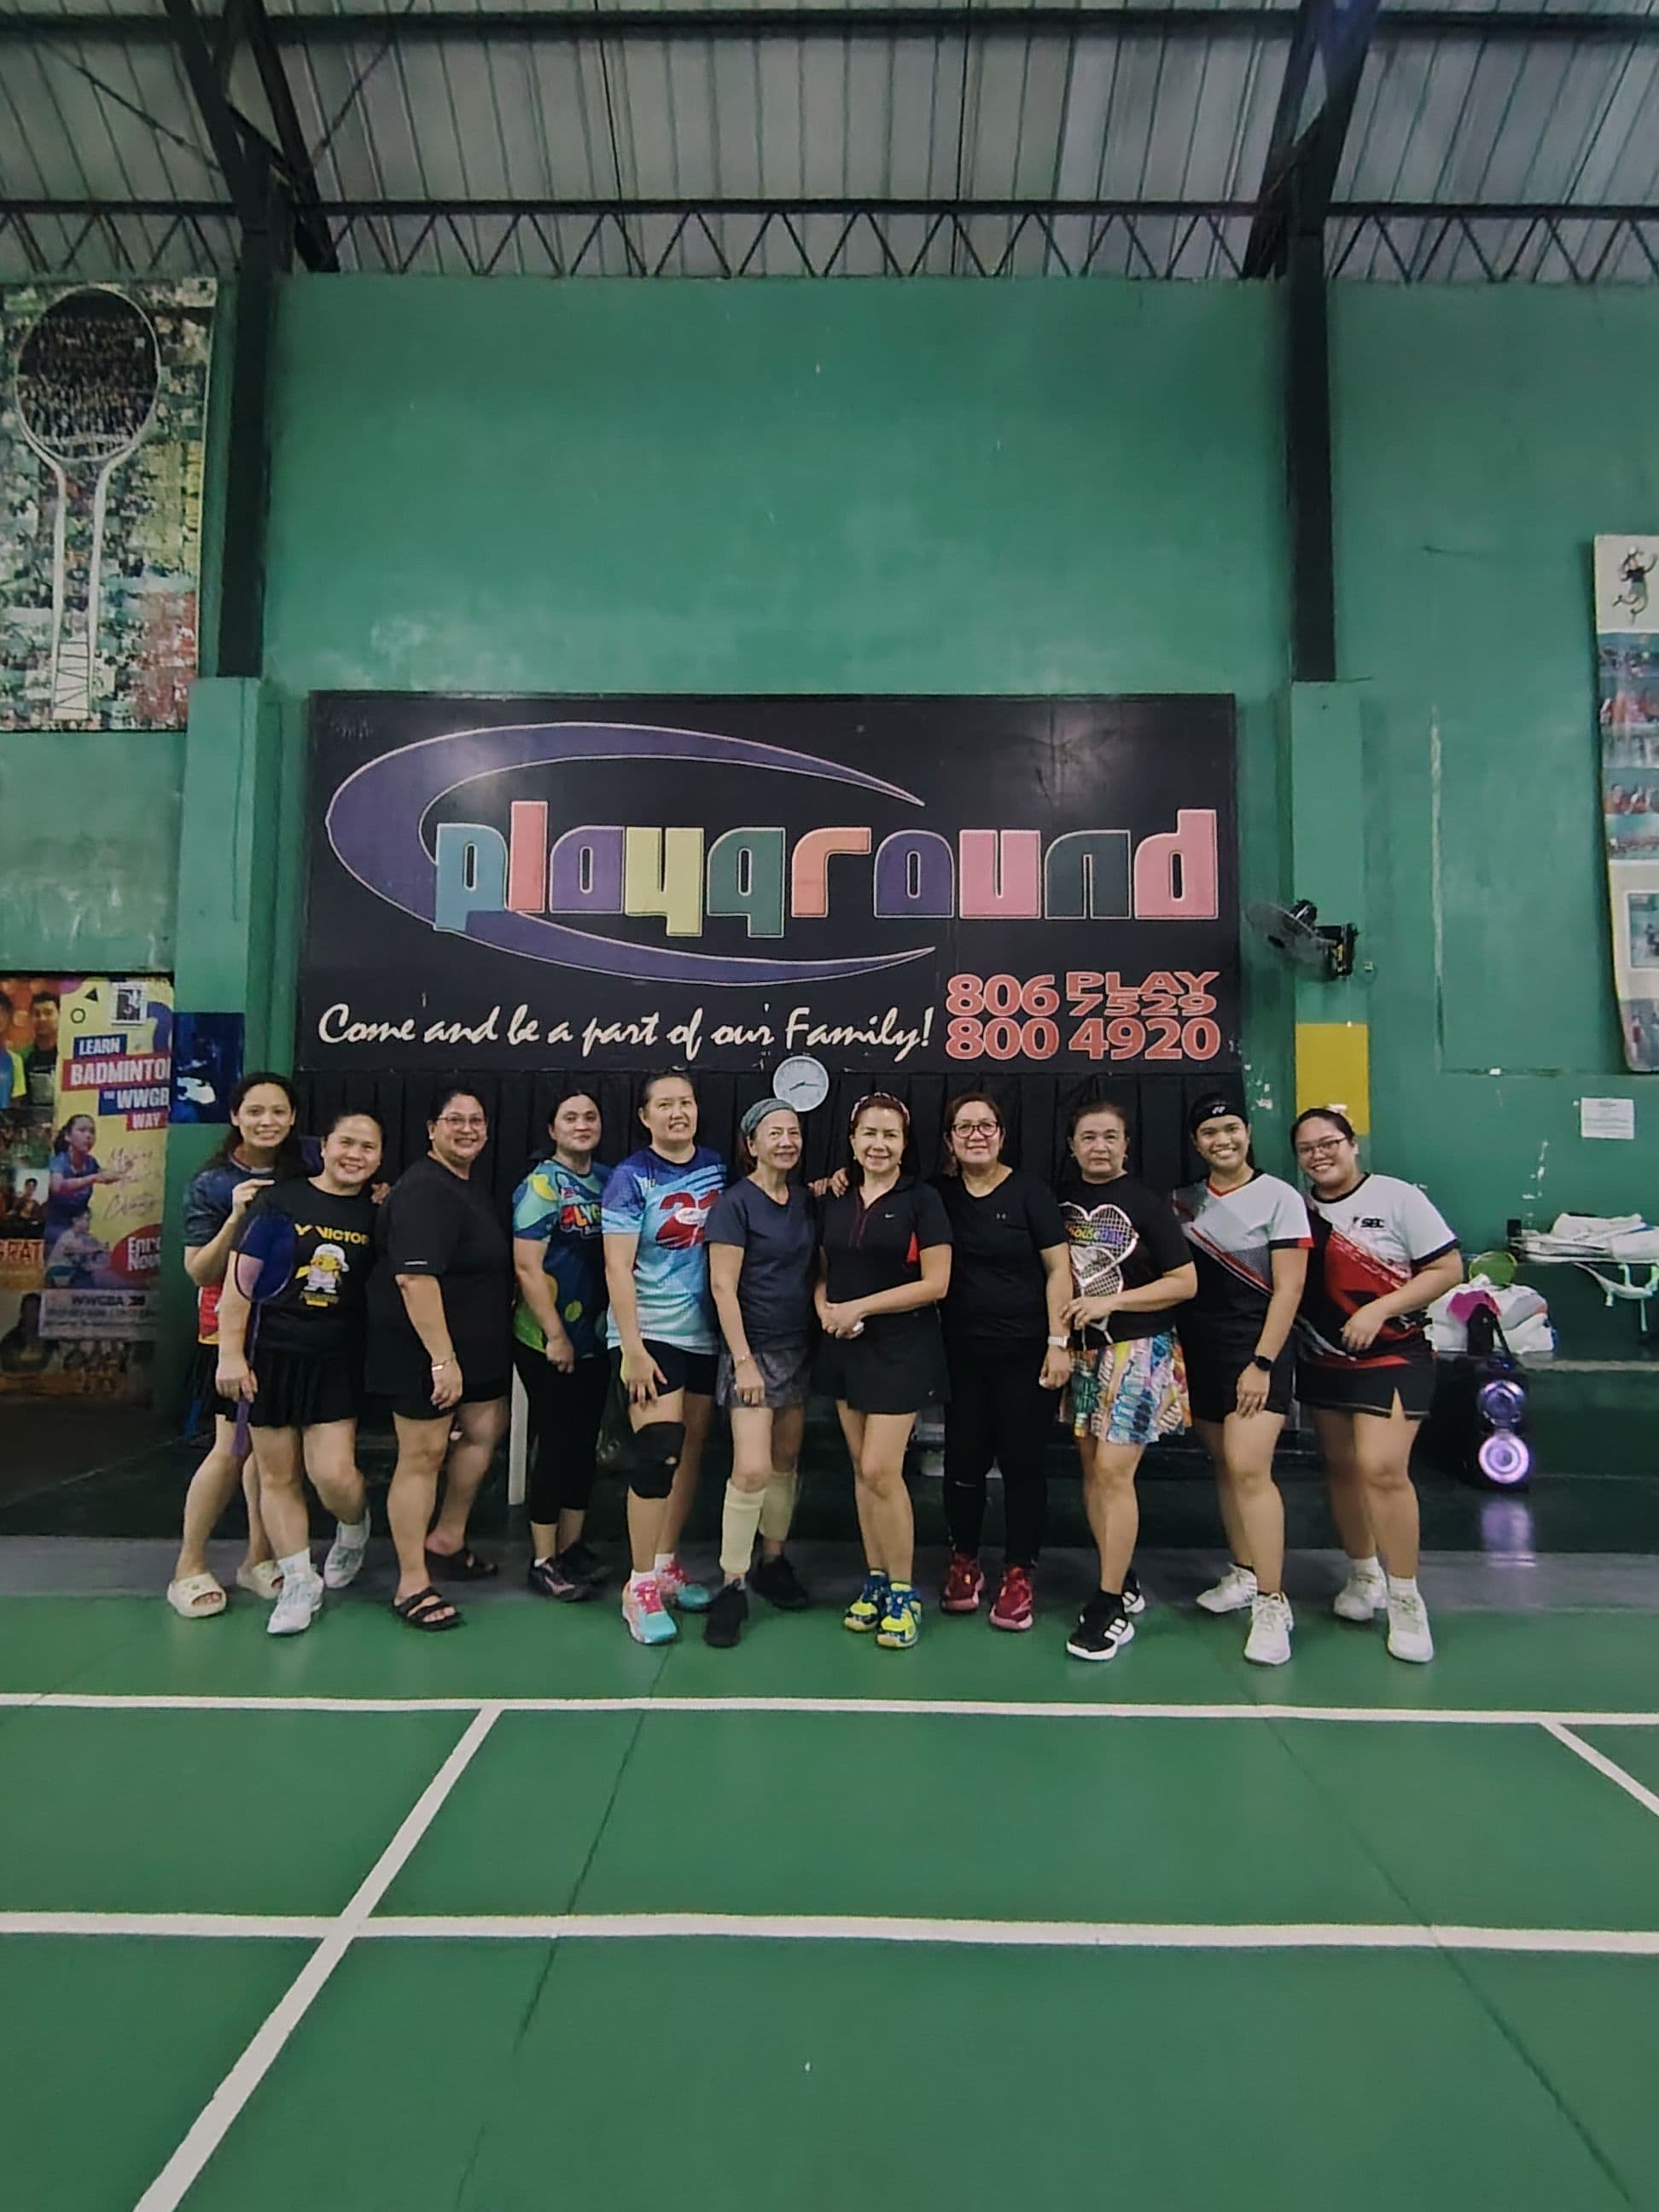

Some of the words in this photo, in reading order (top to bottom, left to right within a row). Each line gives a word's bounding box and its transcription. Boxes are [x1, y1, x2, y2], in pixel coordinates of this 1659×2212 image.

[434, 800, 1219, 938] playground
[946, 974, 1060, 1016] 806
[1066, 971, 1220, 994] PLAY
[1067, 993, 1217, 1016] 7529
[79, 1038, 120, 1055] LEARN
[318, 1003, 416, 1044] Come
[423, 1005, 499, 1044] and
[507, 1004, 540, 1045] be
[547, 1022, 573, 1045] a
[581, 1010, 660, 1057] part
[666, 1007, 703, 1061] of
[710, 1025, 775, 1045] our
[785, 1006, 935, 1062] Family!
[946, 1017, 1060, 1060] 800
[1068, 1017, 1221, 1060] 4920
[131, 1111, 162, 1130] WAY
